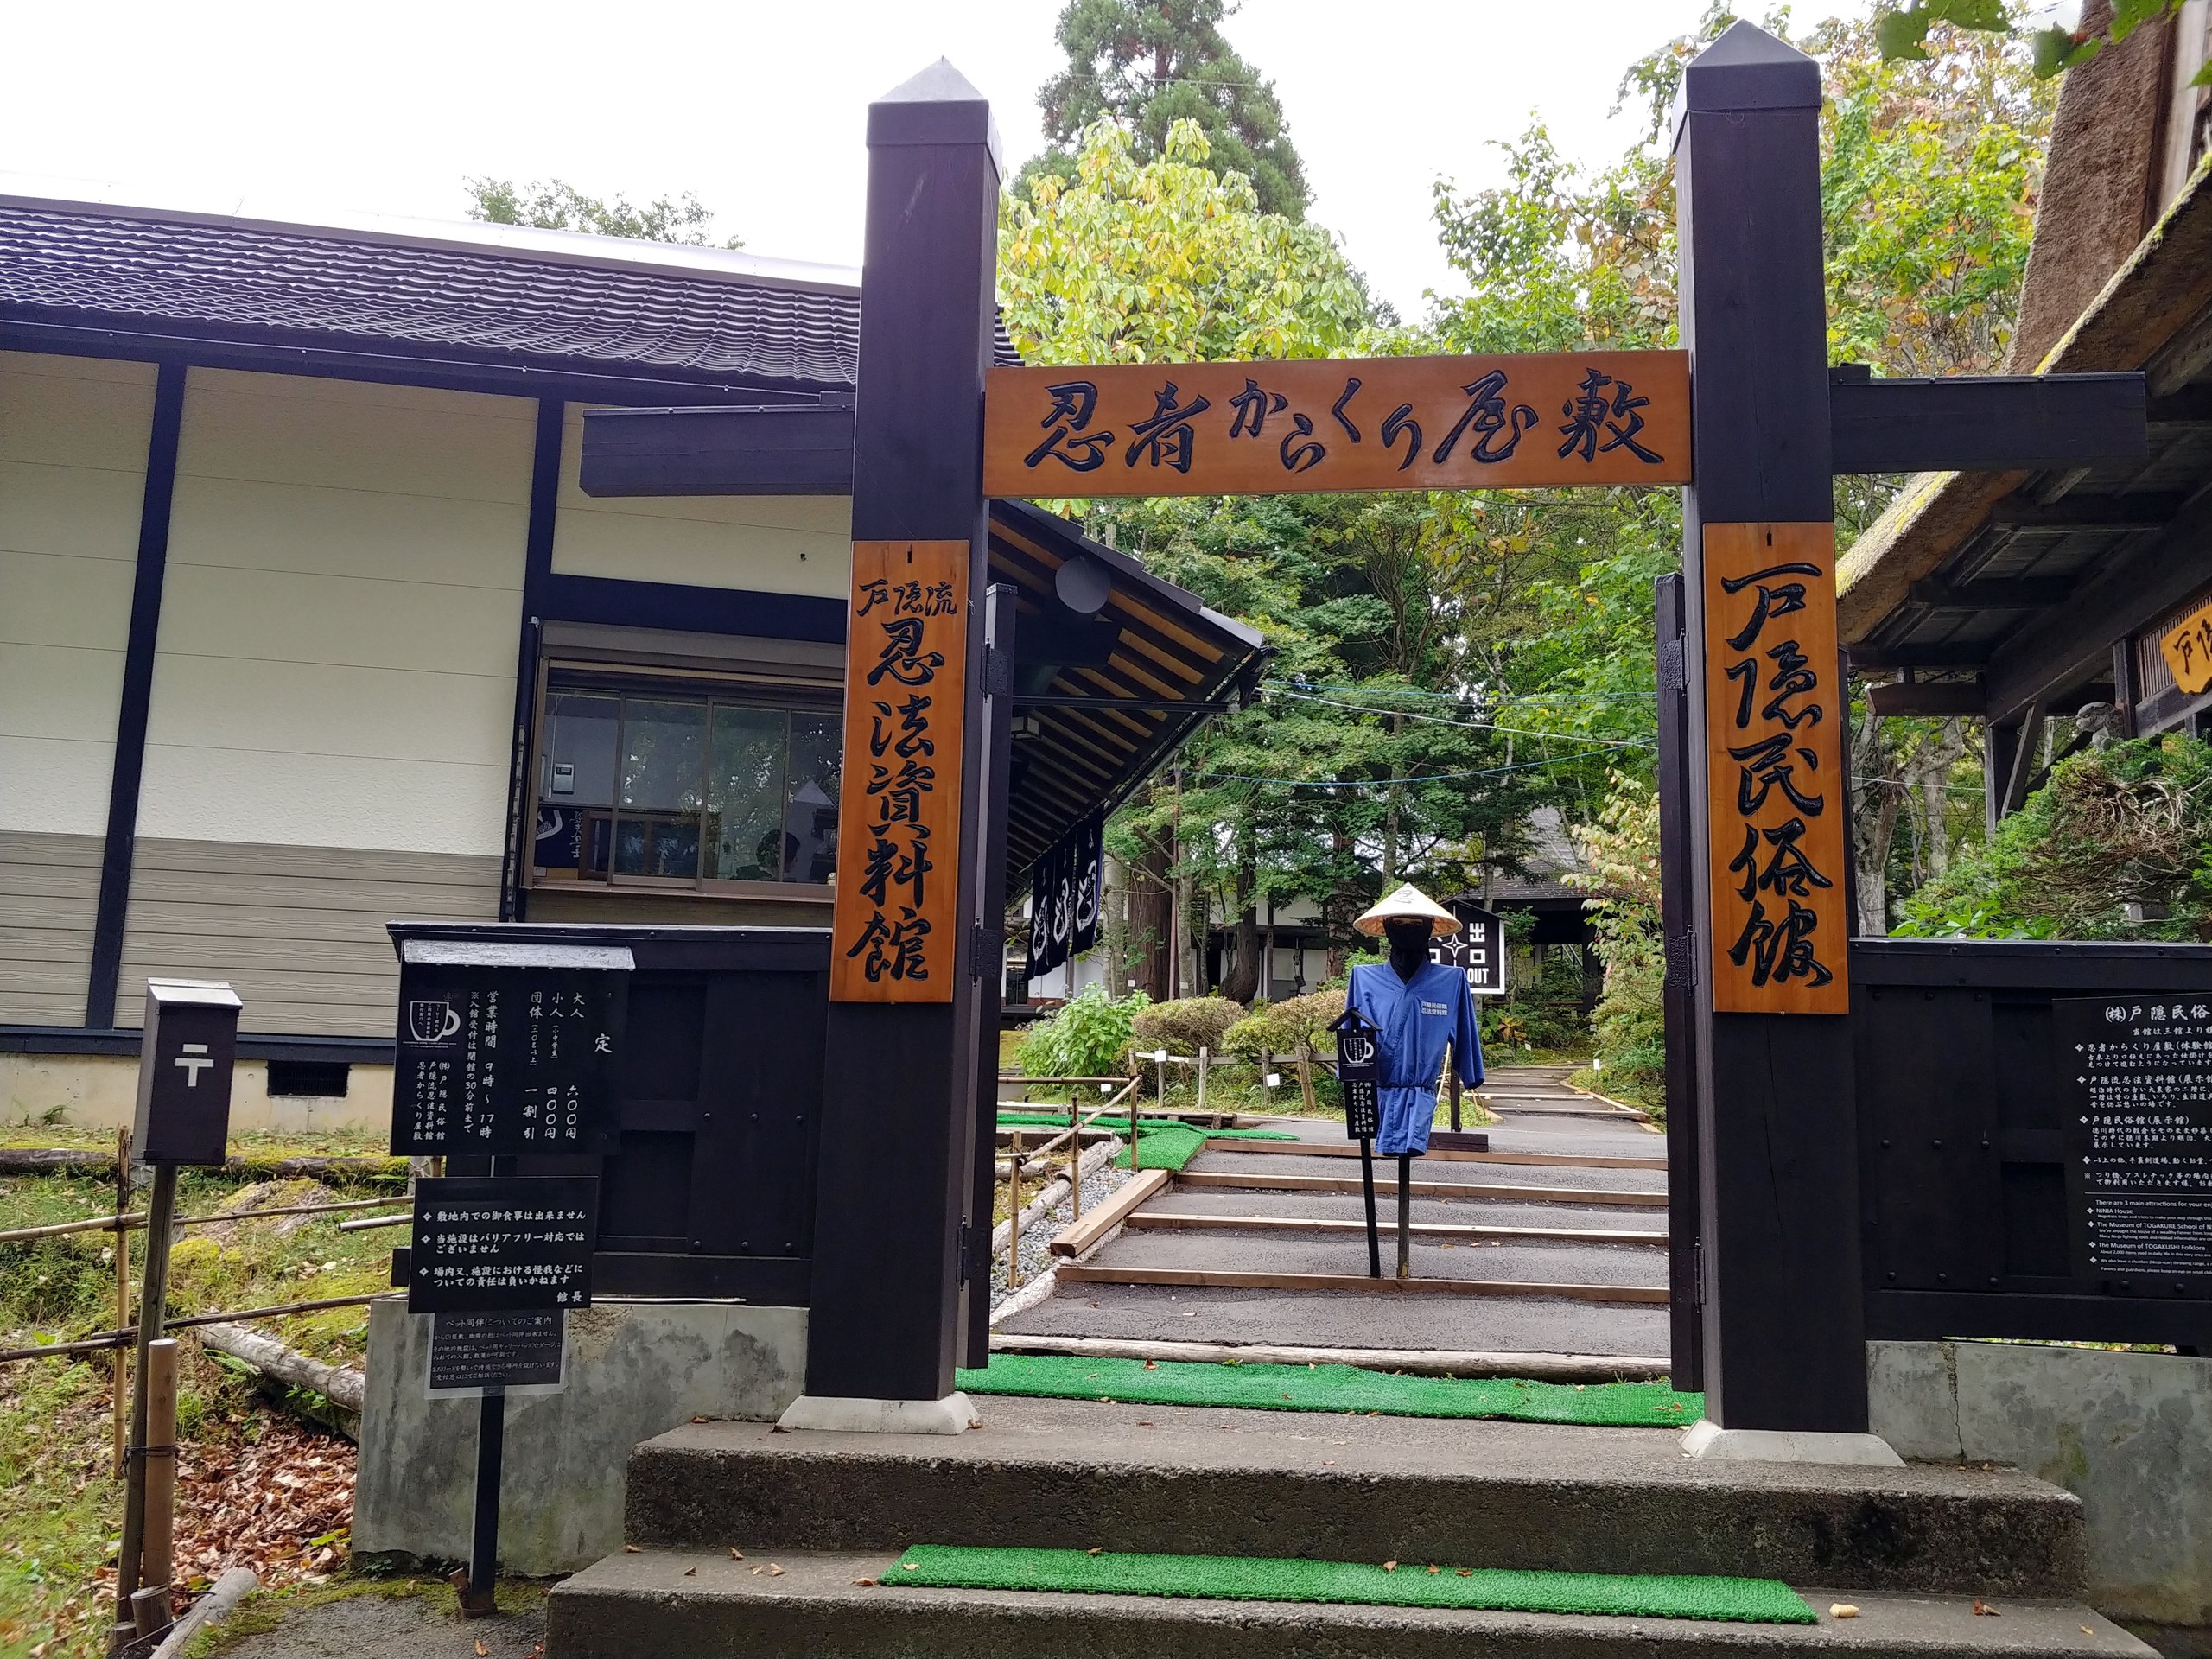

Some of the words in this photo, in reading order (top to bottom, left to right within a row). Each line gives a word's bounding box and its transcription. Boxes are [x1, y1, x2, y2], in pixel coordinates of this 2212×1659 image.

[1024, 368, 1664, 473] 忍者からくり屋敷
[856, 579, 957, 617] 戸隠流
[1720, 562, 1834, 988] 戸隠民俗館
[846, 618, 945, 983] 忍法資料館
[1469, 922, 1486, 964] 出口
[1467, 967, 1490, 984] OUT
[529, 991, 543, 1020] 団体
[549, 992, 564, 1018] 小人
[569, 992, 585, 1018] 大人
[485, 990, 499, 1049] 営業時間
[594, 1033, 613, 1053] 定
[523, 1088, 538, 1140] 一割引
[435, 1210, 587, 1223] 敷地内での御食事は出来ません
[435, 1232, 585, 1245] 当施設はバリアフリー対応では
[435, 1244, 500, 1255] ございません
[433, 1264, 583, 1277] 場内又、施設における怪我などに
[433, 1275, 570, 1287] ついての責任は負いかねます
[446, 1316, 552, 1328] ペット同伴についてのご案内
